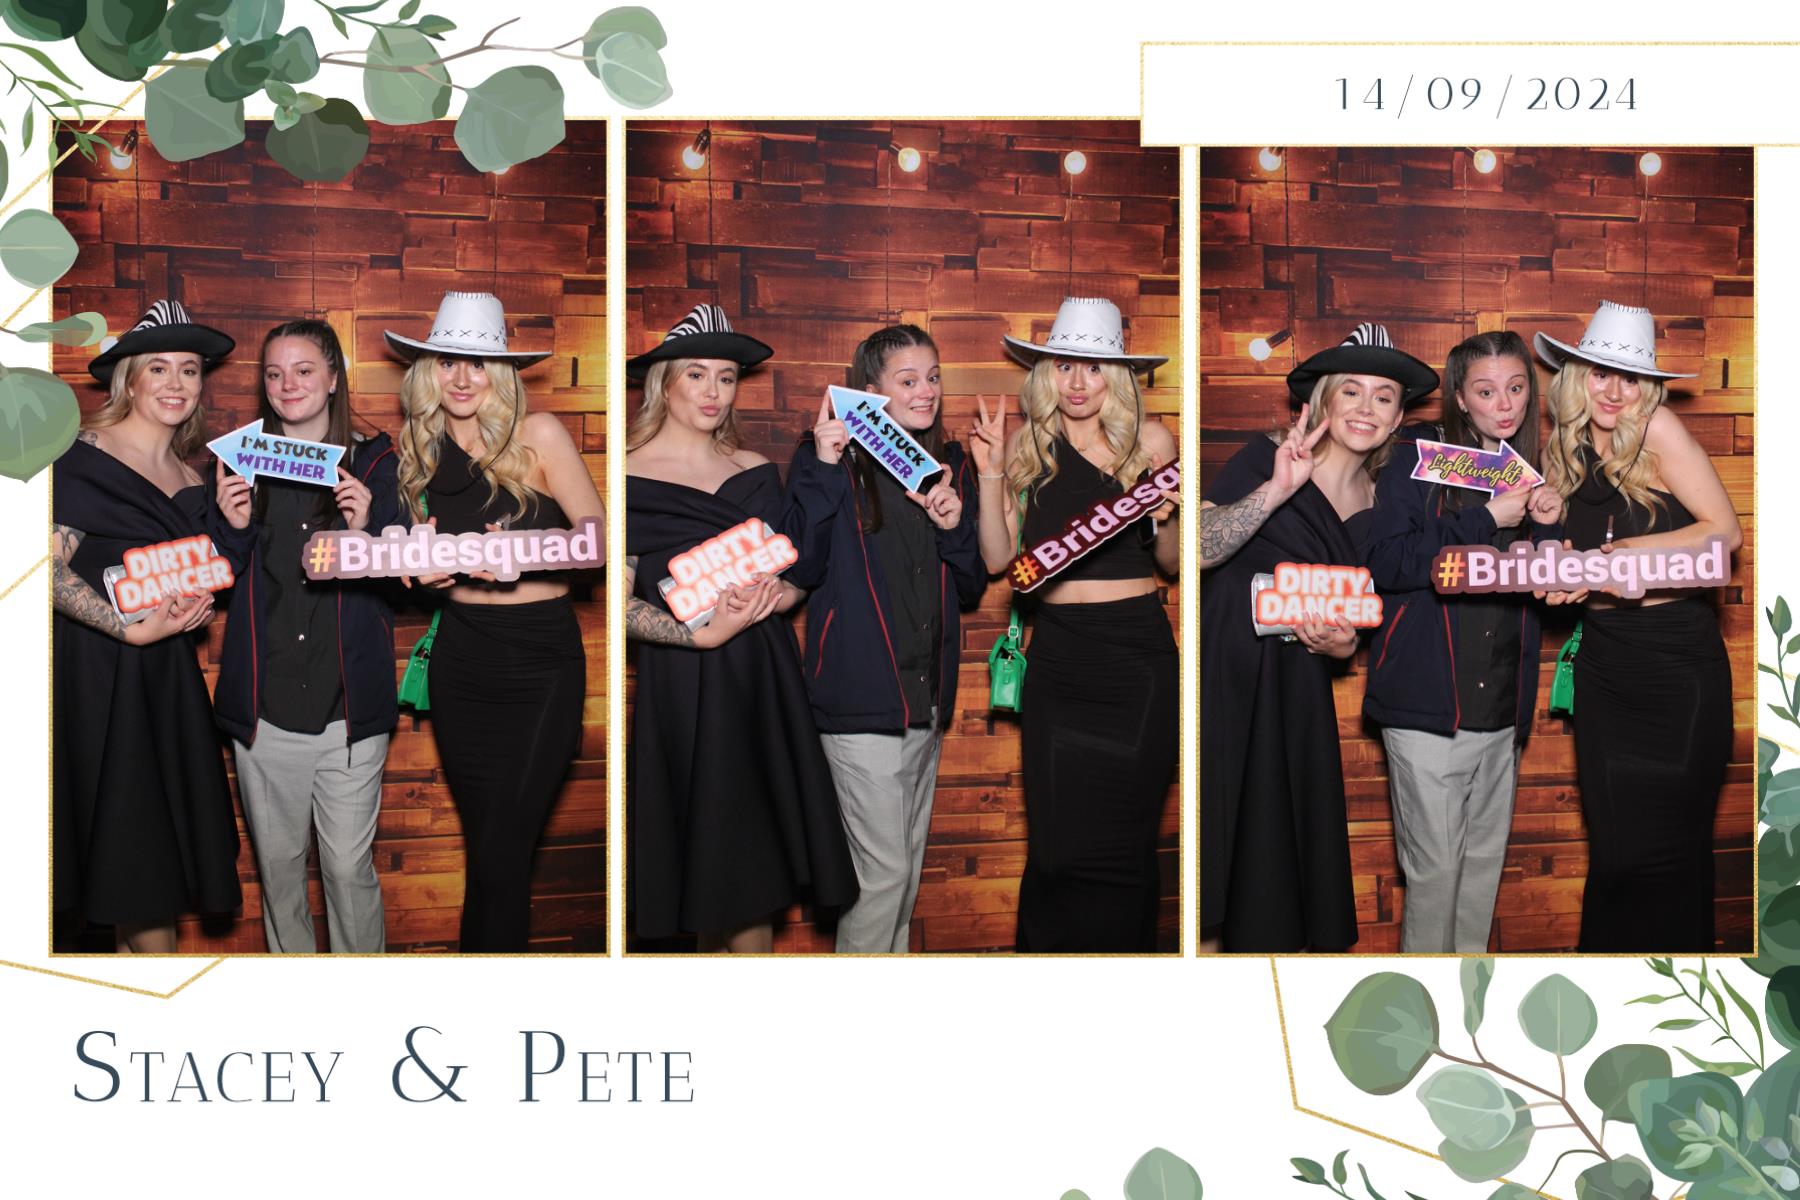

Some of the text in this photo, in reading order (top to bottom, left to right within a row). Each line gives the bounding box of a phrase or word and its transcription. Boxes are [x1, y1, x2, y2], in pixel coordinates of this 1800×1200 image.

[241, 435, 328, 461] I'M STUCK
[844, 410, 914, 479] WITH HER
[857, 400, 926, 467] I'M STUCK
[236, 452, 326, 480] WITH HER
[1428, 453, 1523, 487] Lightweight
[127, 539, 210, 579] DIRTY
[309, 522, 598, 574] #Bridesquad
[672, 520, 762, 584] DIRTY
[1438, 541, 1723, 591] #Bridesquad
[120, 559, 232, 610] DANCER
[668, 538, 796, 617] DANCER
[1279, 566, 1367, 596] DIRTY
[1260, 593, 1380, 625] DANCER
